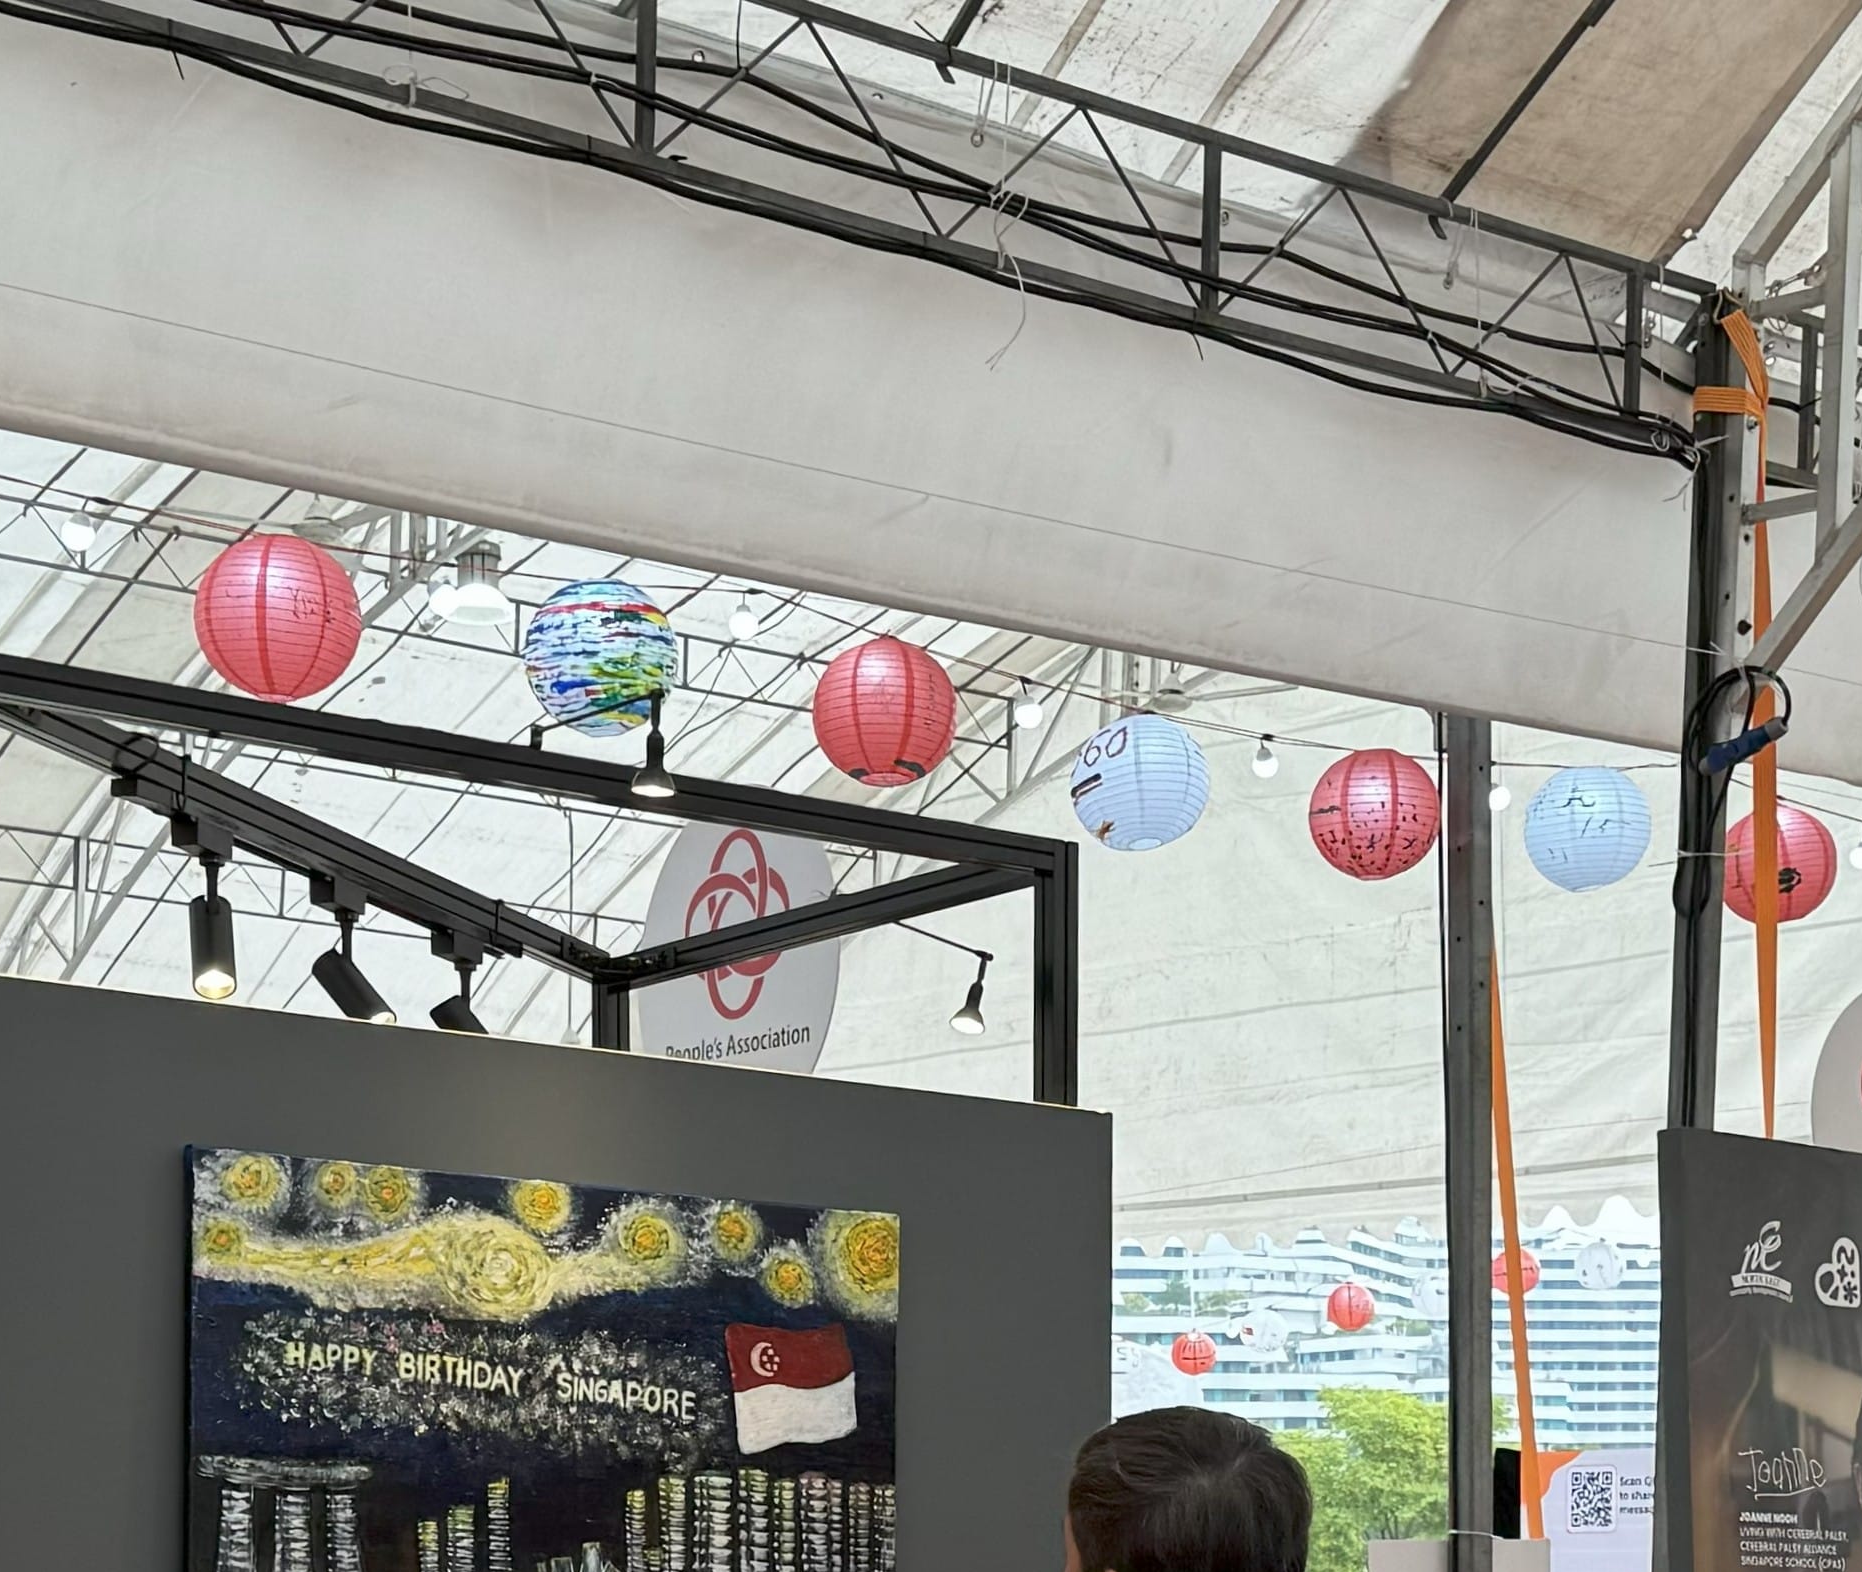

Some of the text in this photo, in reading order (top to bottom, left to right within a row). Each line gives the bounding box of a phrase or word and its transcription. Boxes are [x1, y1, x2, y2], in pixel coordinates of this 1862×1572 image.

[725, 1025, 811, 1057] Association
[284, 1342, 698, 1422] HAPPY BIRTHDAY SINGAPORE
